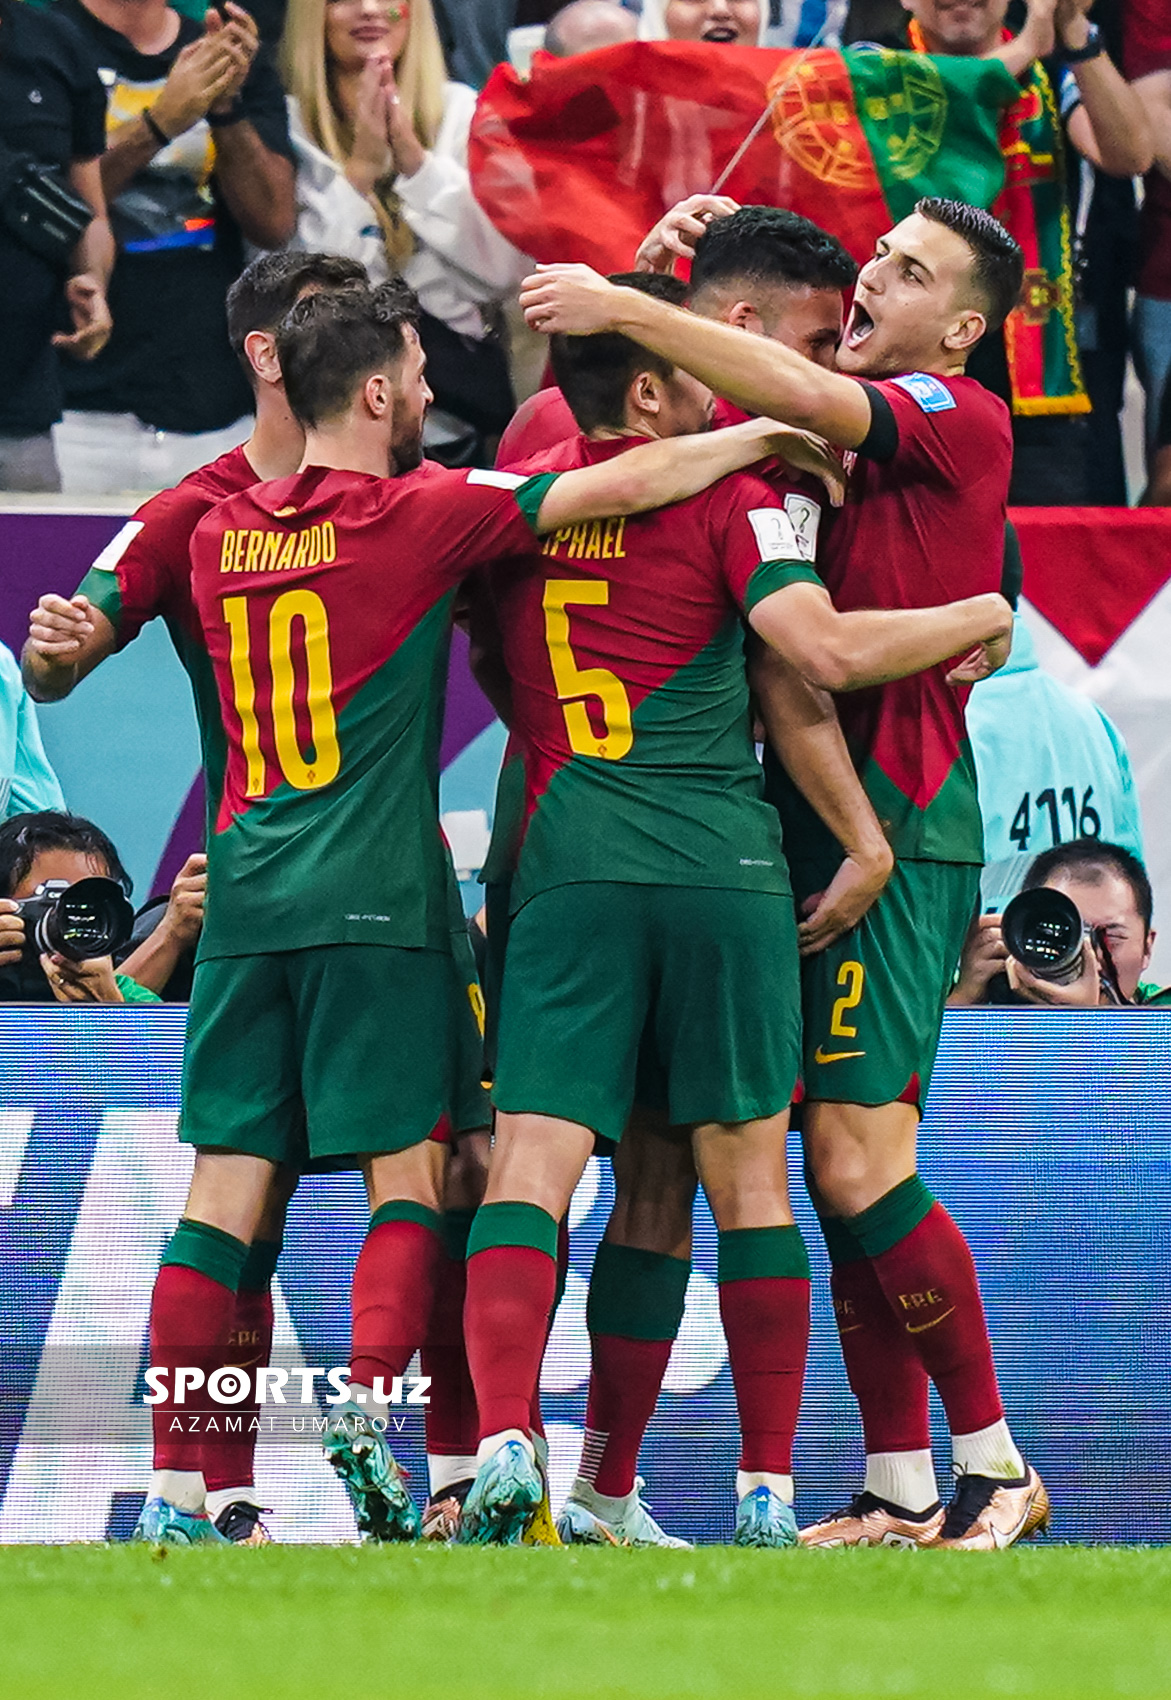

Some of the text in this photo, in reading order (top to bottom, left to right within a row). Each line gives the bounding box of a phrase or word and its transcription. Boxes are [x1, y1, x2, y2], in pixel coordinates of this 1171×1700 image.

[220, 521, 337, 573] BERNARDO
[542, 516, 626, 559] PHAEL
[222, 588, 341, 797] 10
[542, 579, 634, 760] 5
[830, 960, 864, 1038] 2
